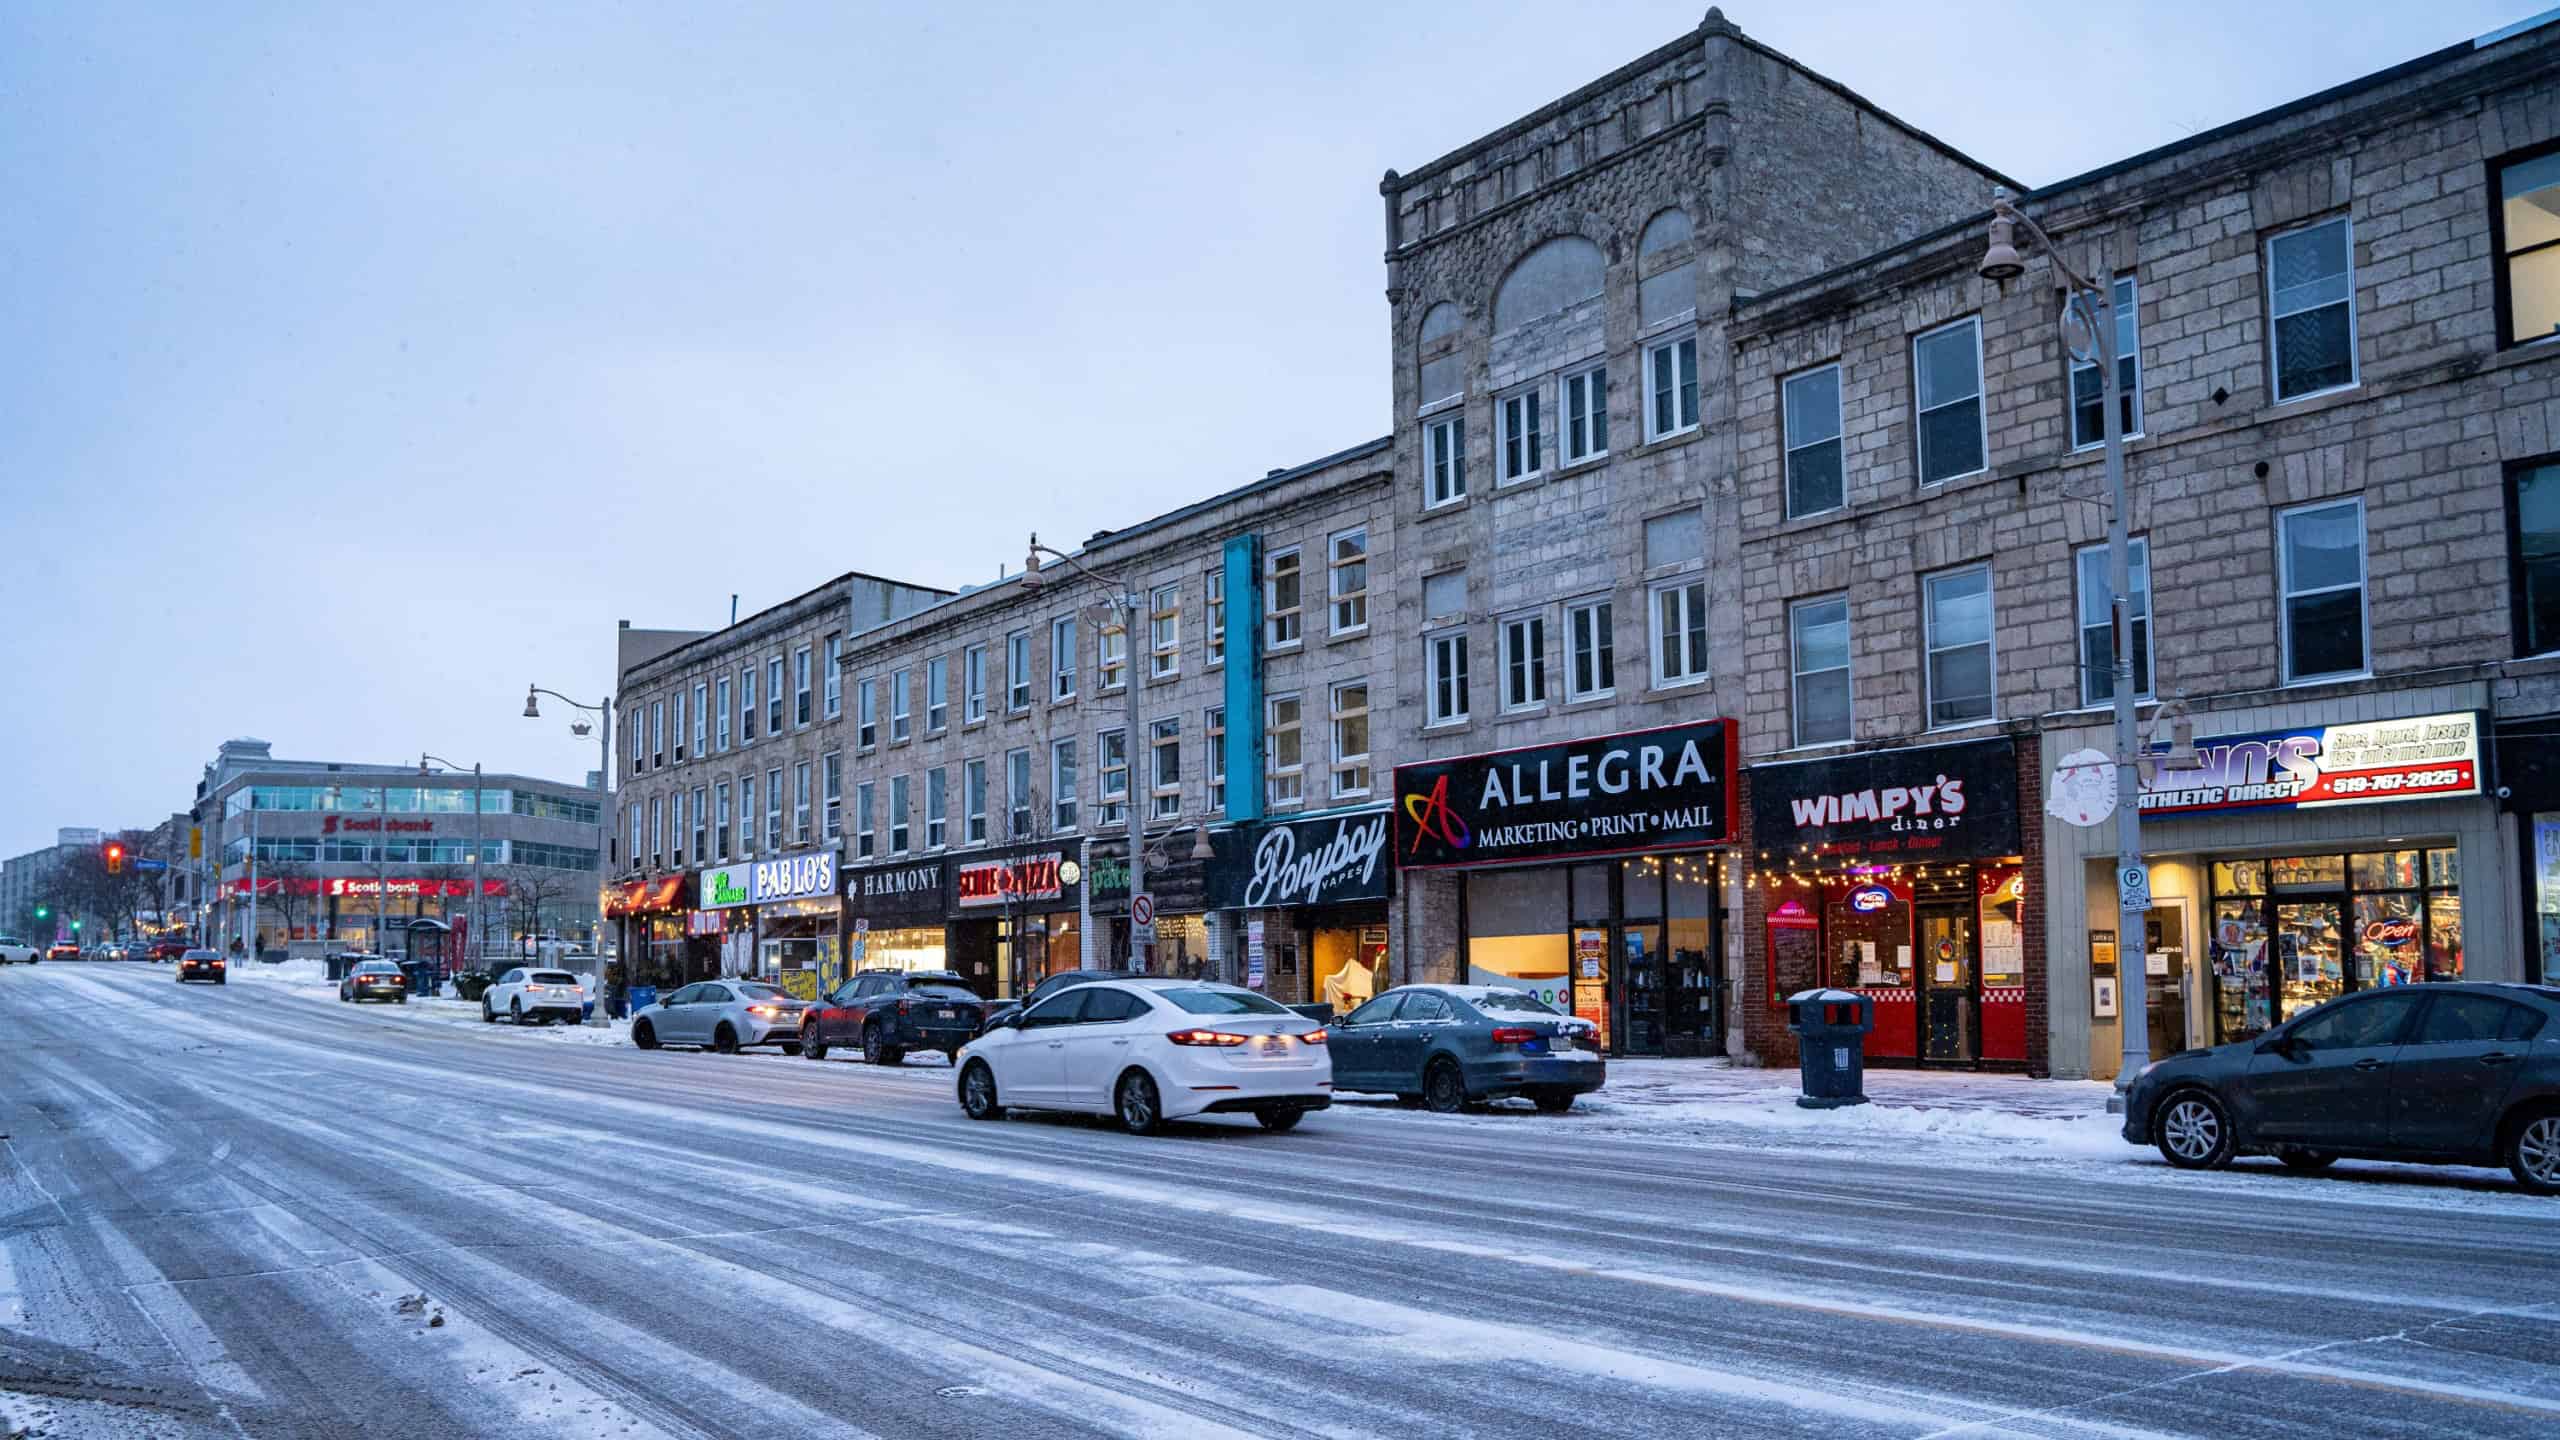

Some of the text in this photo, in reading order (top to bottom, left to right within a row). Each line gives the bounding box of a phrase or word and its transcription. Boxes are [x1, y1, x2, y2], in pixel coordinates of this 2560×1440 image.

[2422, 722, 2470, 742] Jerseys
[2399, 742, 2432, 761] much
[2432, 740, 2466, 758] more
[1480, 739, 1711, 810] ALLEGRA
[1791, 774, 1967, 829] WIMPY'S
[2138, 779, 2305, 809] ATHLETIC DIRECT
[1478, 806, 1713, 848] MARKETING PRINT MAIL
[1890, 815, 1961, 832] diner
[1244, 814, 1386, 908] Ponyboy
[347, 881, 420, 894] Scotibank
[756, 853, 832, 900] PABLO'S
[863, 866, 939, 896] HARMONY
[1322, 865, 1364, 890] VAPES
[2366, 921, 2415, 941] Open
